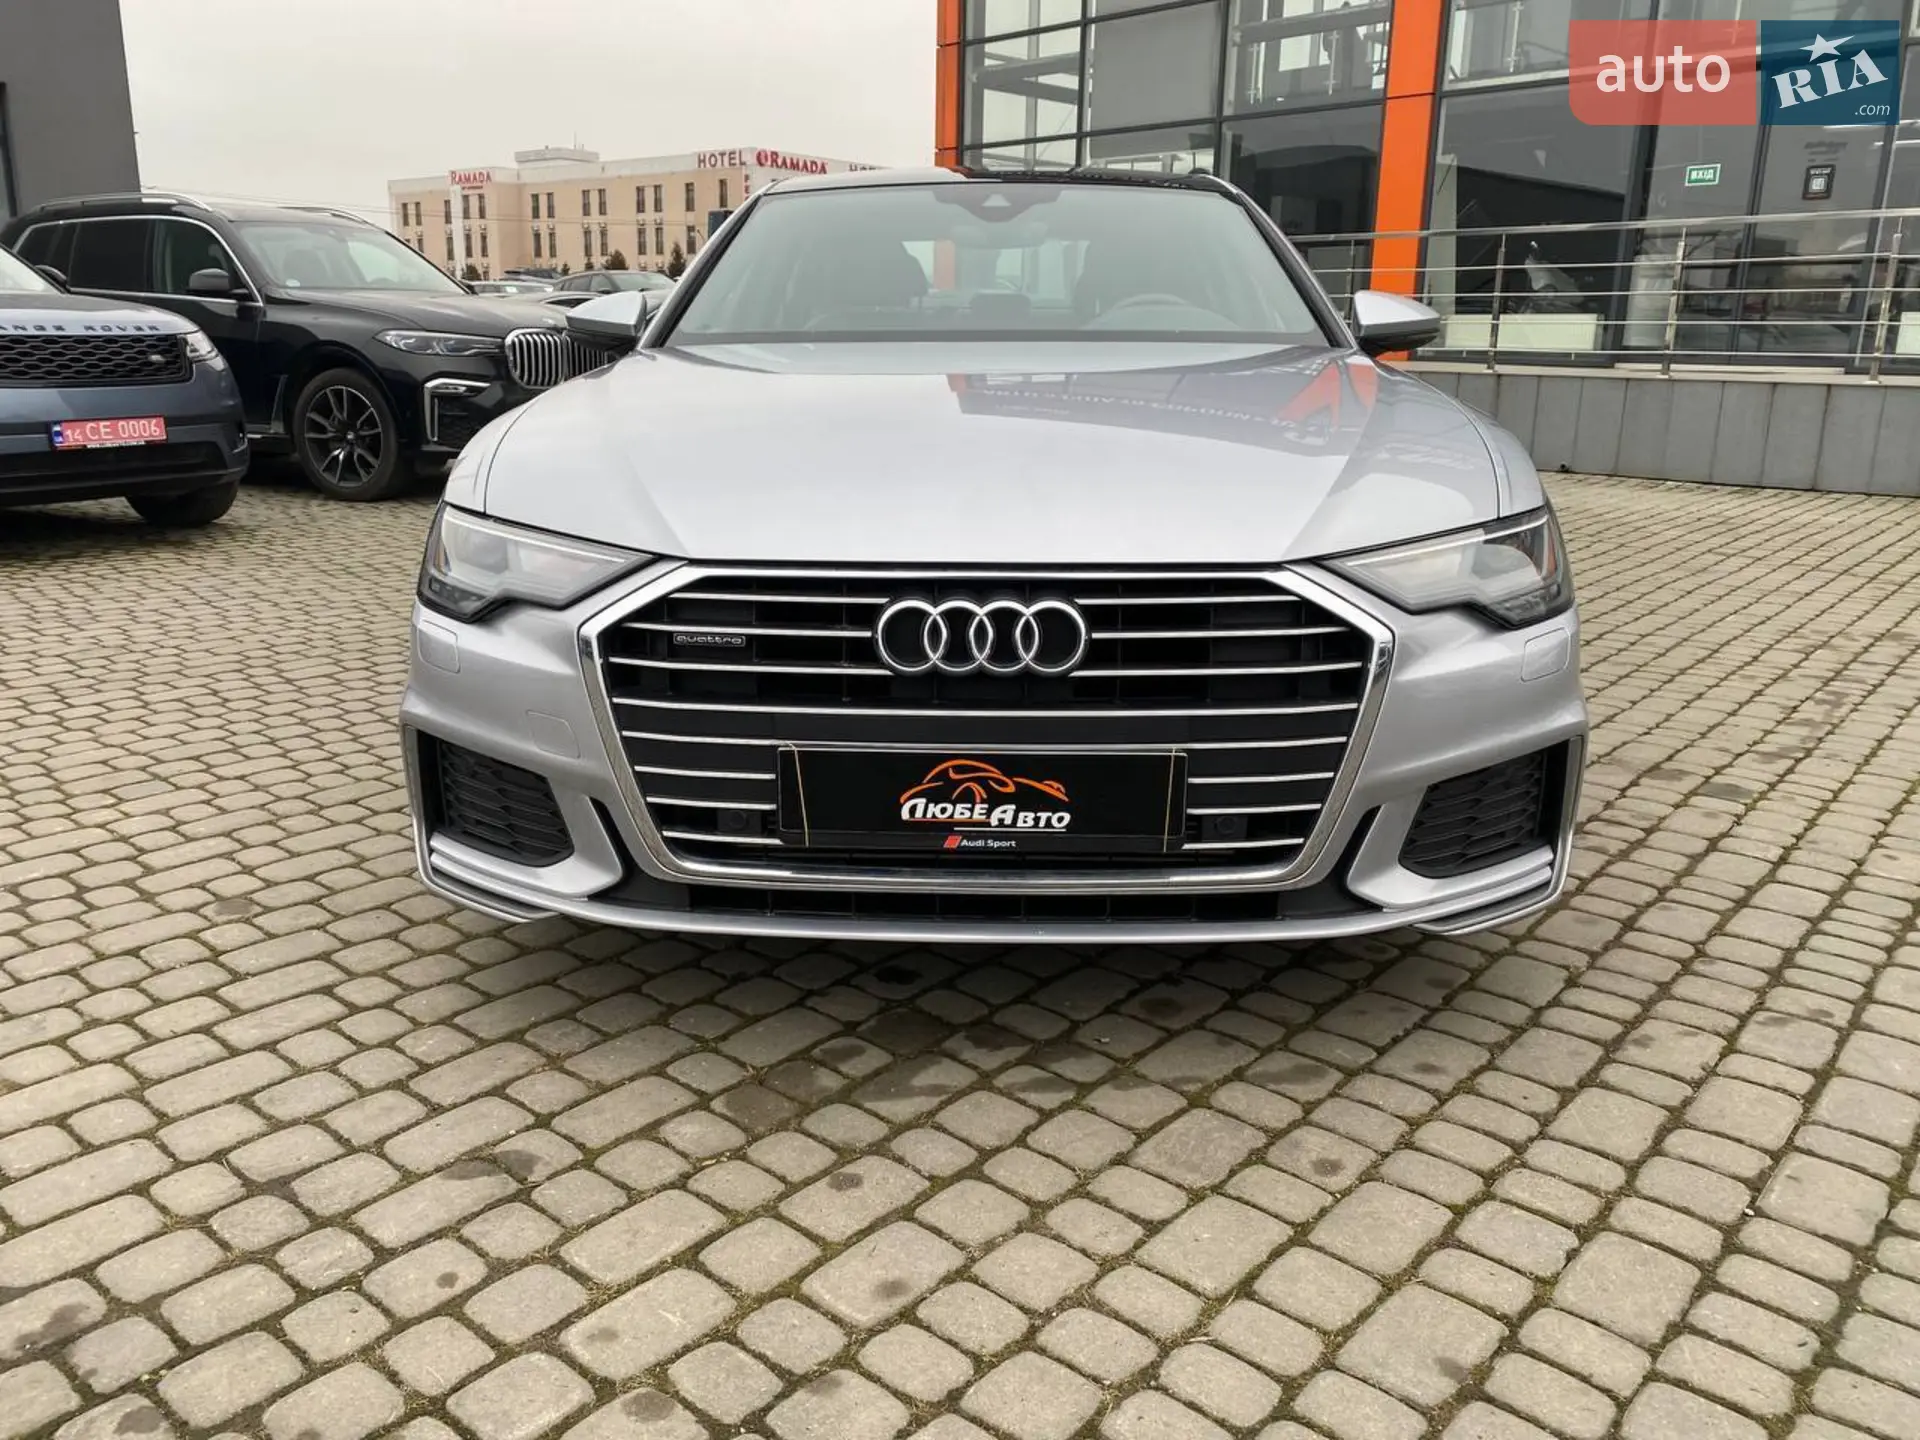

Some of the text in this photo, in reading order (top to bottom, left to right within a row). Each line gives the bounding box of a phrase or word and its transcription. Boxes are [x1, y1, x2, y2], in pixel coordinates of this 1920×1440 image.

[697, 151, 746, 169] HOTEL
[770, 151, 828, 175] RAMADA
[451, 170, 492, 185] RAMADA
[83, 324, 161, 332] ROVER
[66, 419, 160, 442] 14 CE 0006
[676, 635, 742, 646] quattro
[960, 838, 1017, 849] Audi Sport
